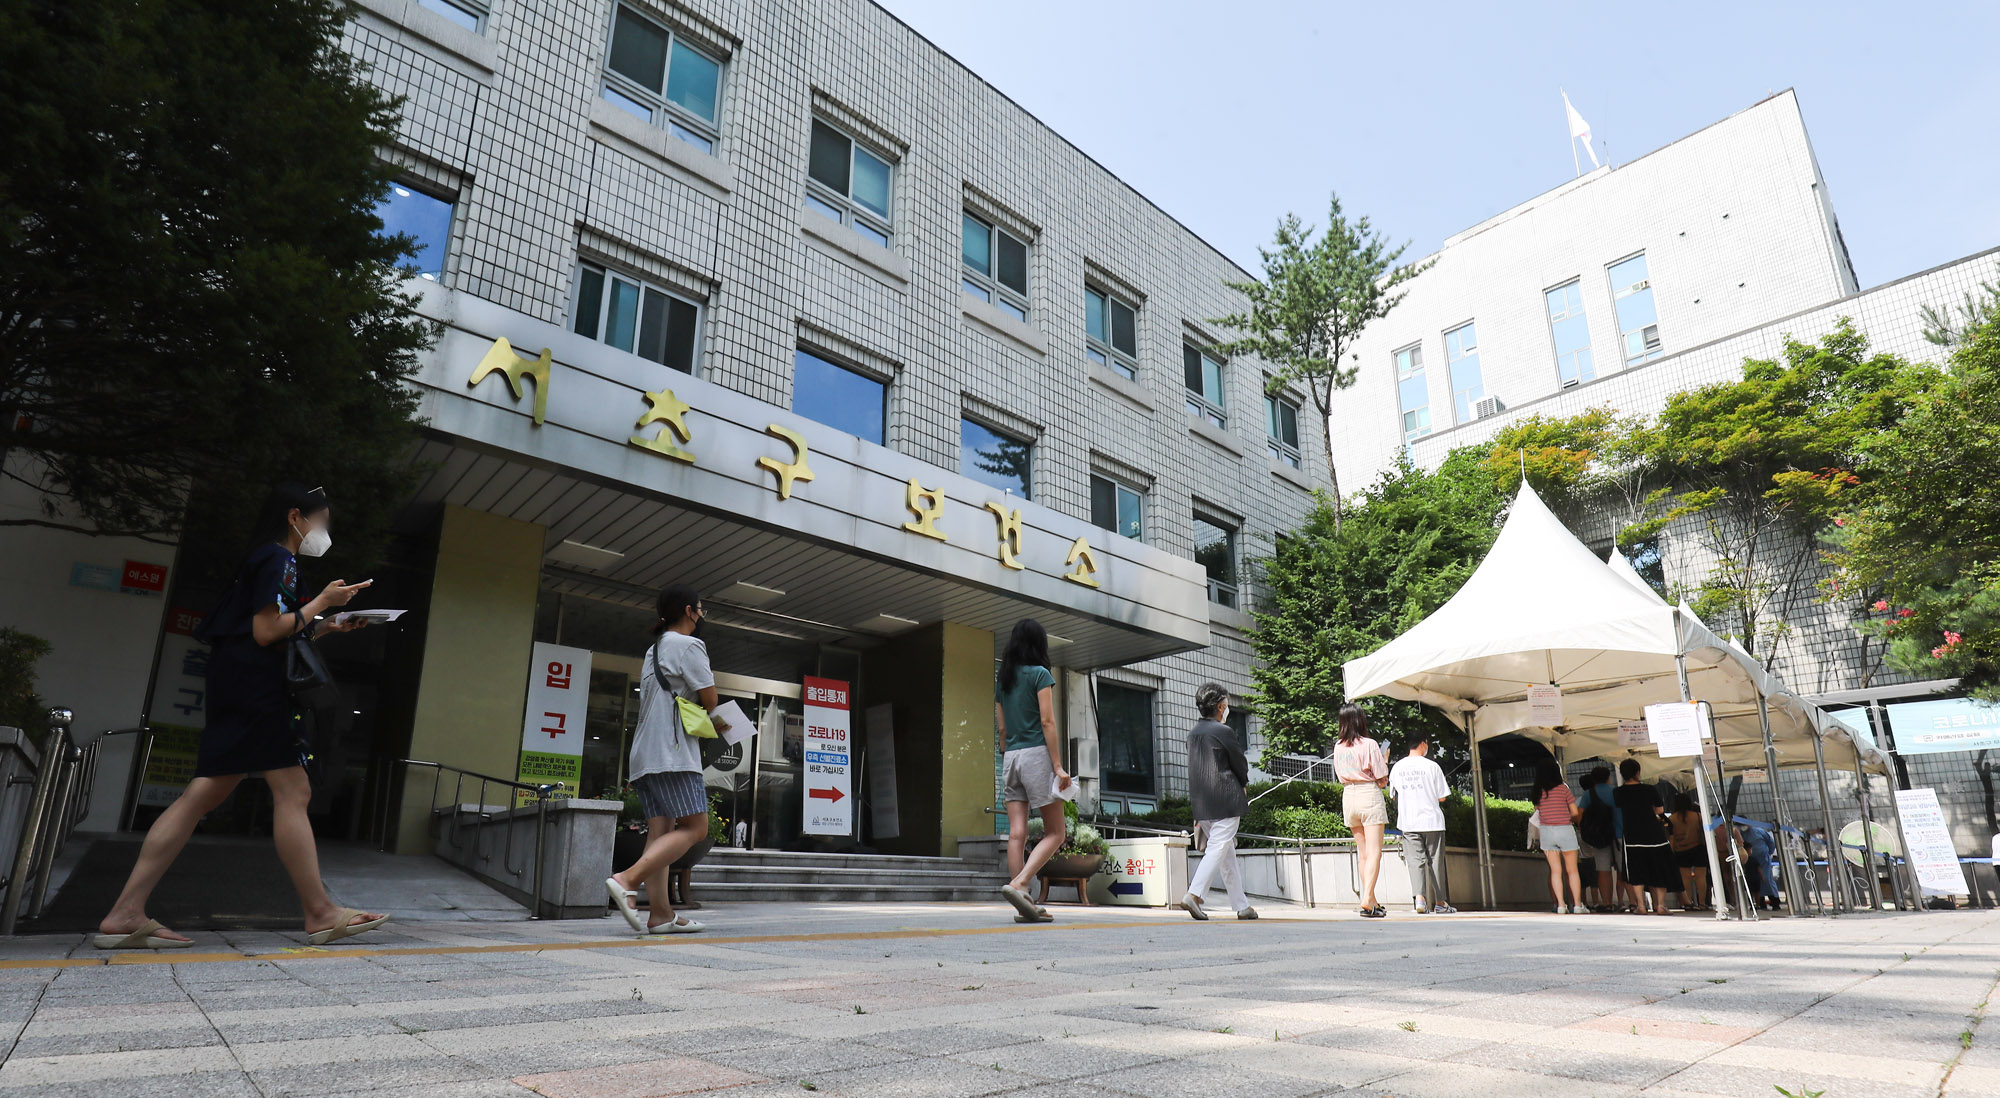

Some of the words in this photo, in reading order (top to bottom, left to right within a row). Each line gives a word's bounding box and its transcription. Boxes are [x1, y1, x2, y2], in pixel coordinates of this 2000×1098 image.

[468, 336, 815, 501] 서초구
[901, 477, 1101, 588] 보건소
[128, 570, 160, 584] 에스원
[540, 661, 572, 739] 입구
[807, 686, 847, 705] 출입통제
[1932, 711, 2000, 729] 코로나1
[808, 725, 846, 742] 코로나19
[807, 752, 818, 762] 우측
[820, 754, 847, 764] 선별진료소
[809, 764, 821, 773] 바로
[822, 765, 844, 775] 가십시오
[1125, 858, 1156, 876] 출입구
